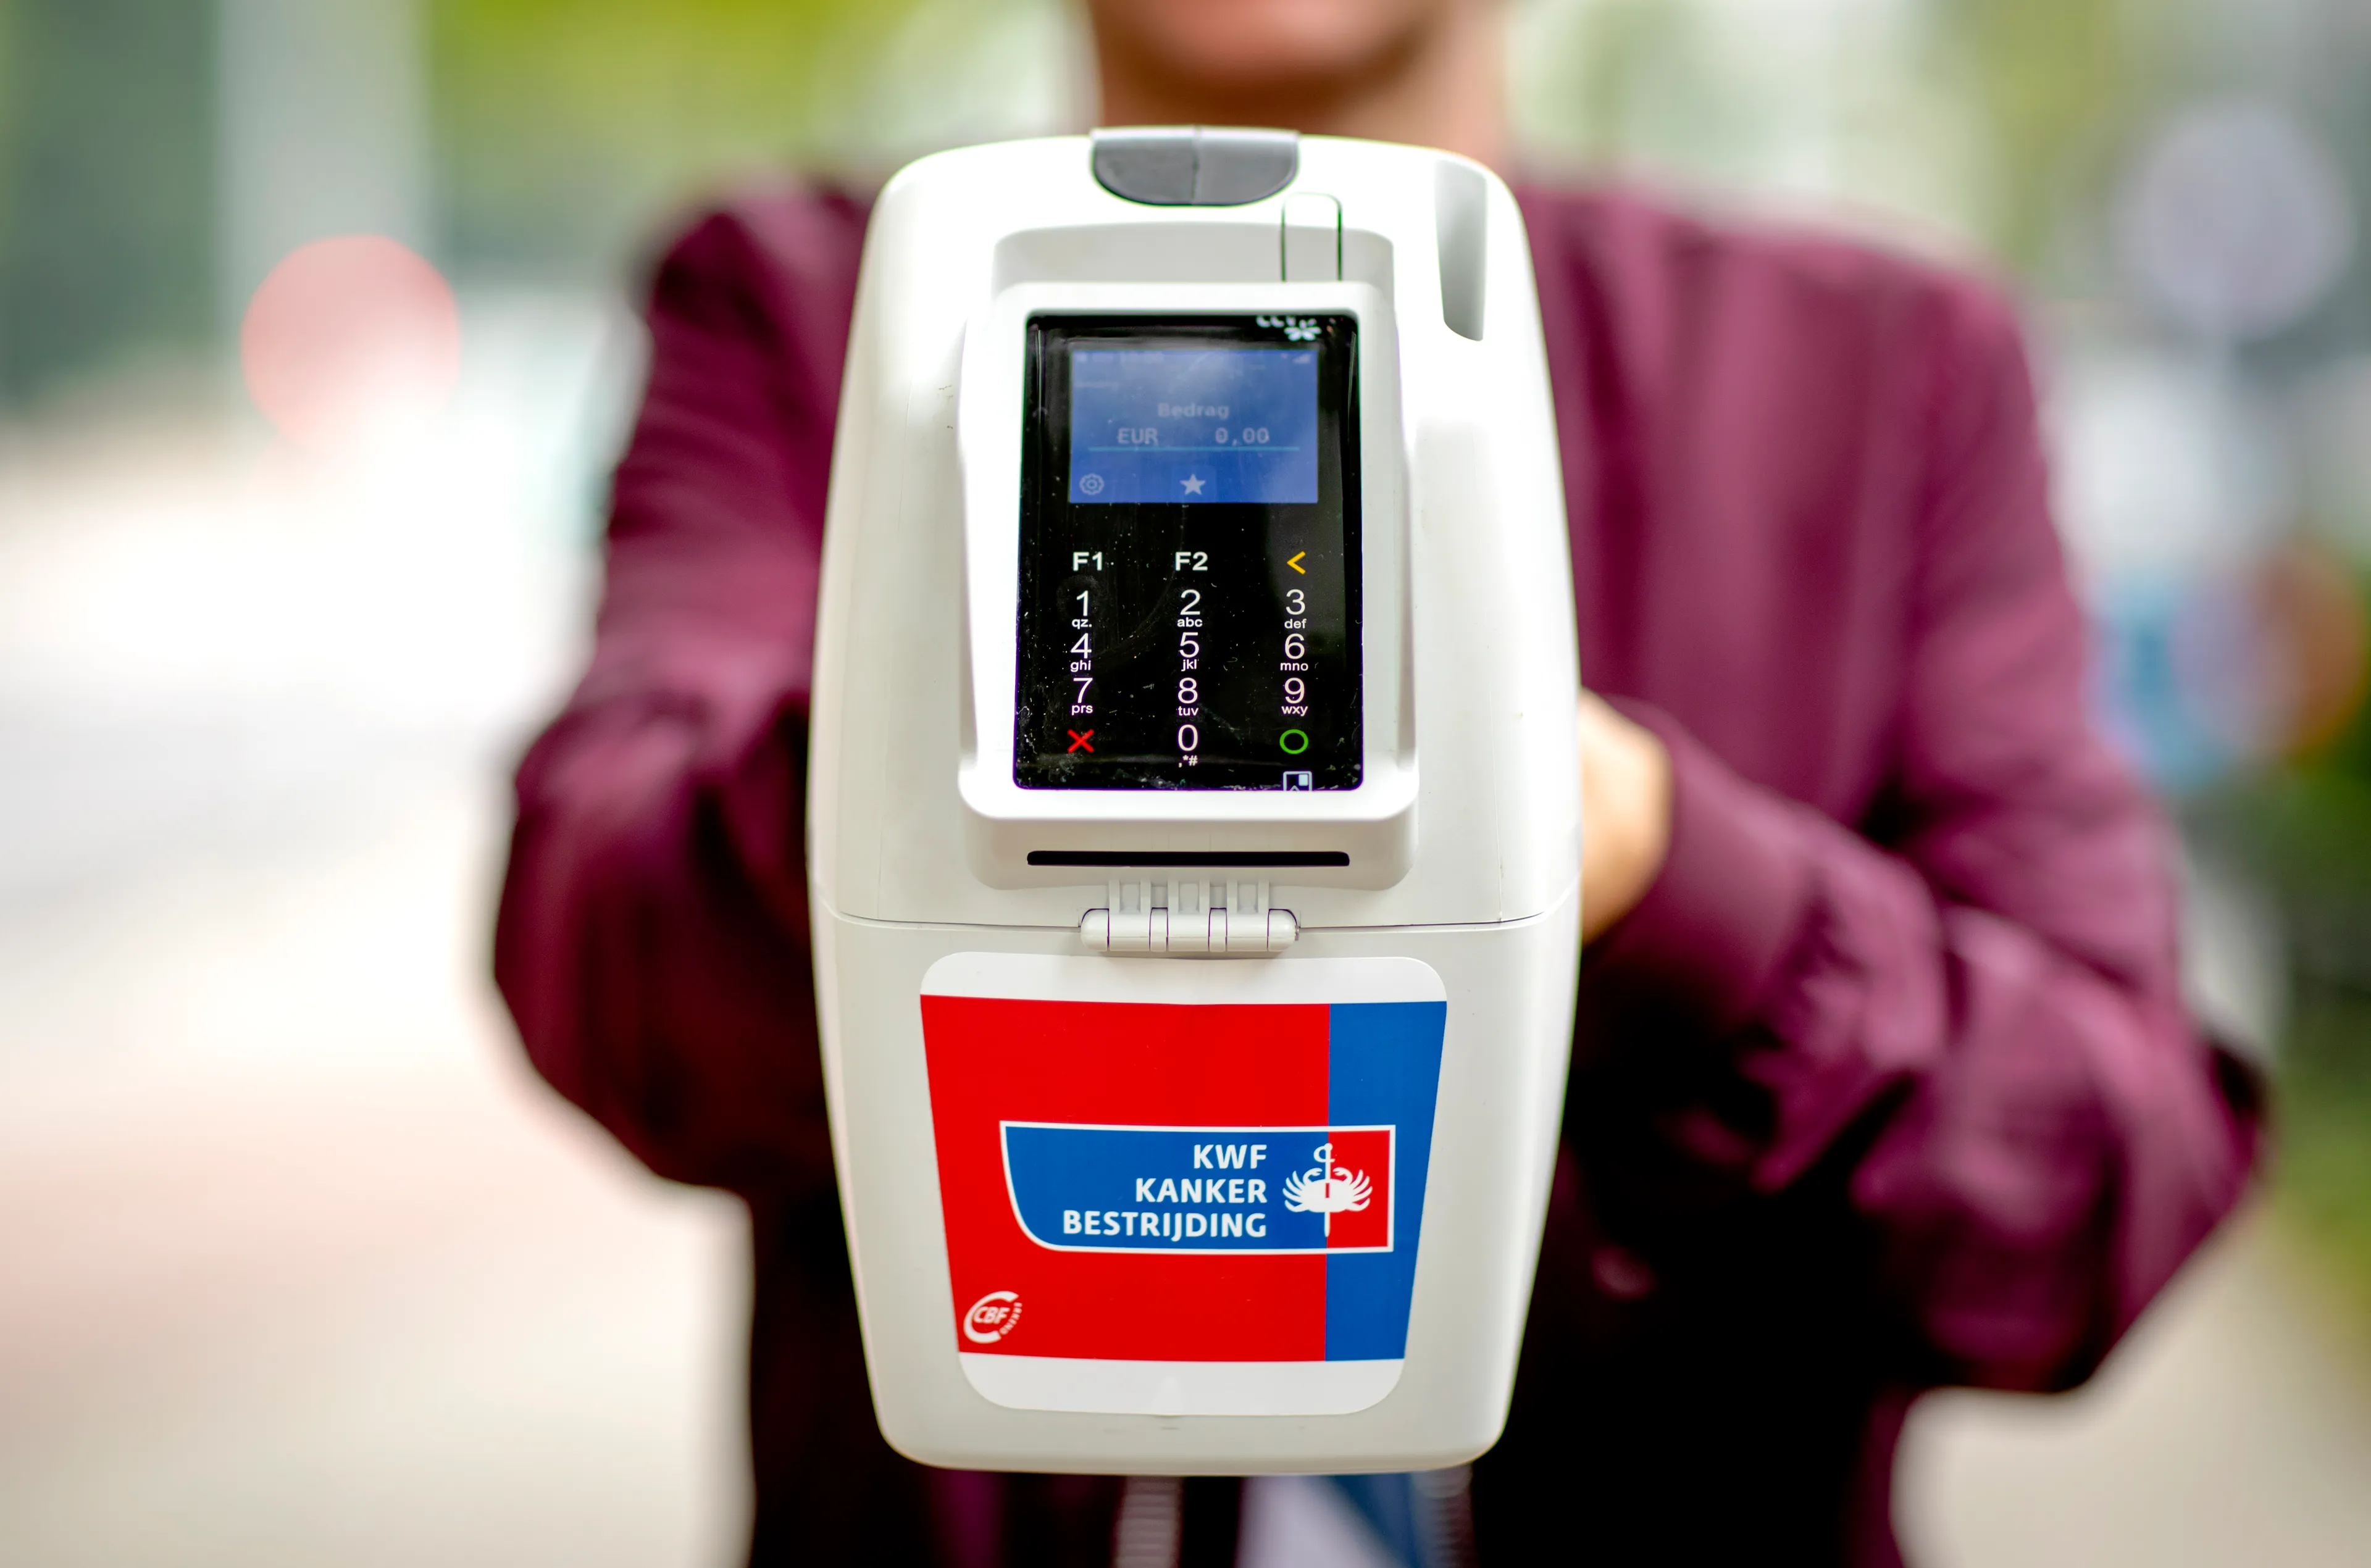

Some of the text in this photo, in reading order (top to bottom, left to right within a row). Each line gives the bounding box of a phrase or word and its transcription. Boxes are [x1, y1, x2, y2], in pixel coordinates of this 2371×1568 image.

[1157, 402, 1229, 420] Bedrag
[1117, 427, 1270, 445] EUR 0,00
[1073, 551, 1102, 571] F1
[1176, 551, 1208, 571] F2
[1076, 590, 1089, 617] 1
[1180, 589, 1200, 615] 2
[1286, 589, 1306, 615] 3
[1071, 619, 1092, 630] qz.
[1177, 617, 1203, 627] abc
[1284, 618, 1307, 629] def
[1070, 632, 1092, 659] 4
[1179, 632, 1200, 658] 5
[1284, 633, 1305, 659] 6
[1070, 659, 1091, 673] ghi
[1181, 659, 1197, 672] jkl
[1280, 662, 1308, 671] mno
[1073, 677, 1093, 704] 7
[1177, 677, 1198, 704] 8
[1284, 677, 1305, 704] 9
[1071, 705, 1093, 716] prs
[1177, 706, 1199, 716] tuv
[1281, 706, 1308, 717] wxy
[1178, 724, 1198, 751] 0
[1194, 1144, 1268, 1169] KWF
[1135, 1178, 1268, 1203] KANKER
[1063, 1210, 1266, 1242] BESTRIJDING
[974, 1306, 1011, 1325] CBF
